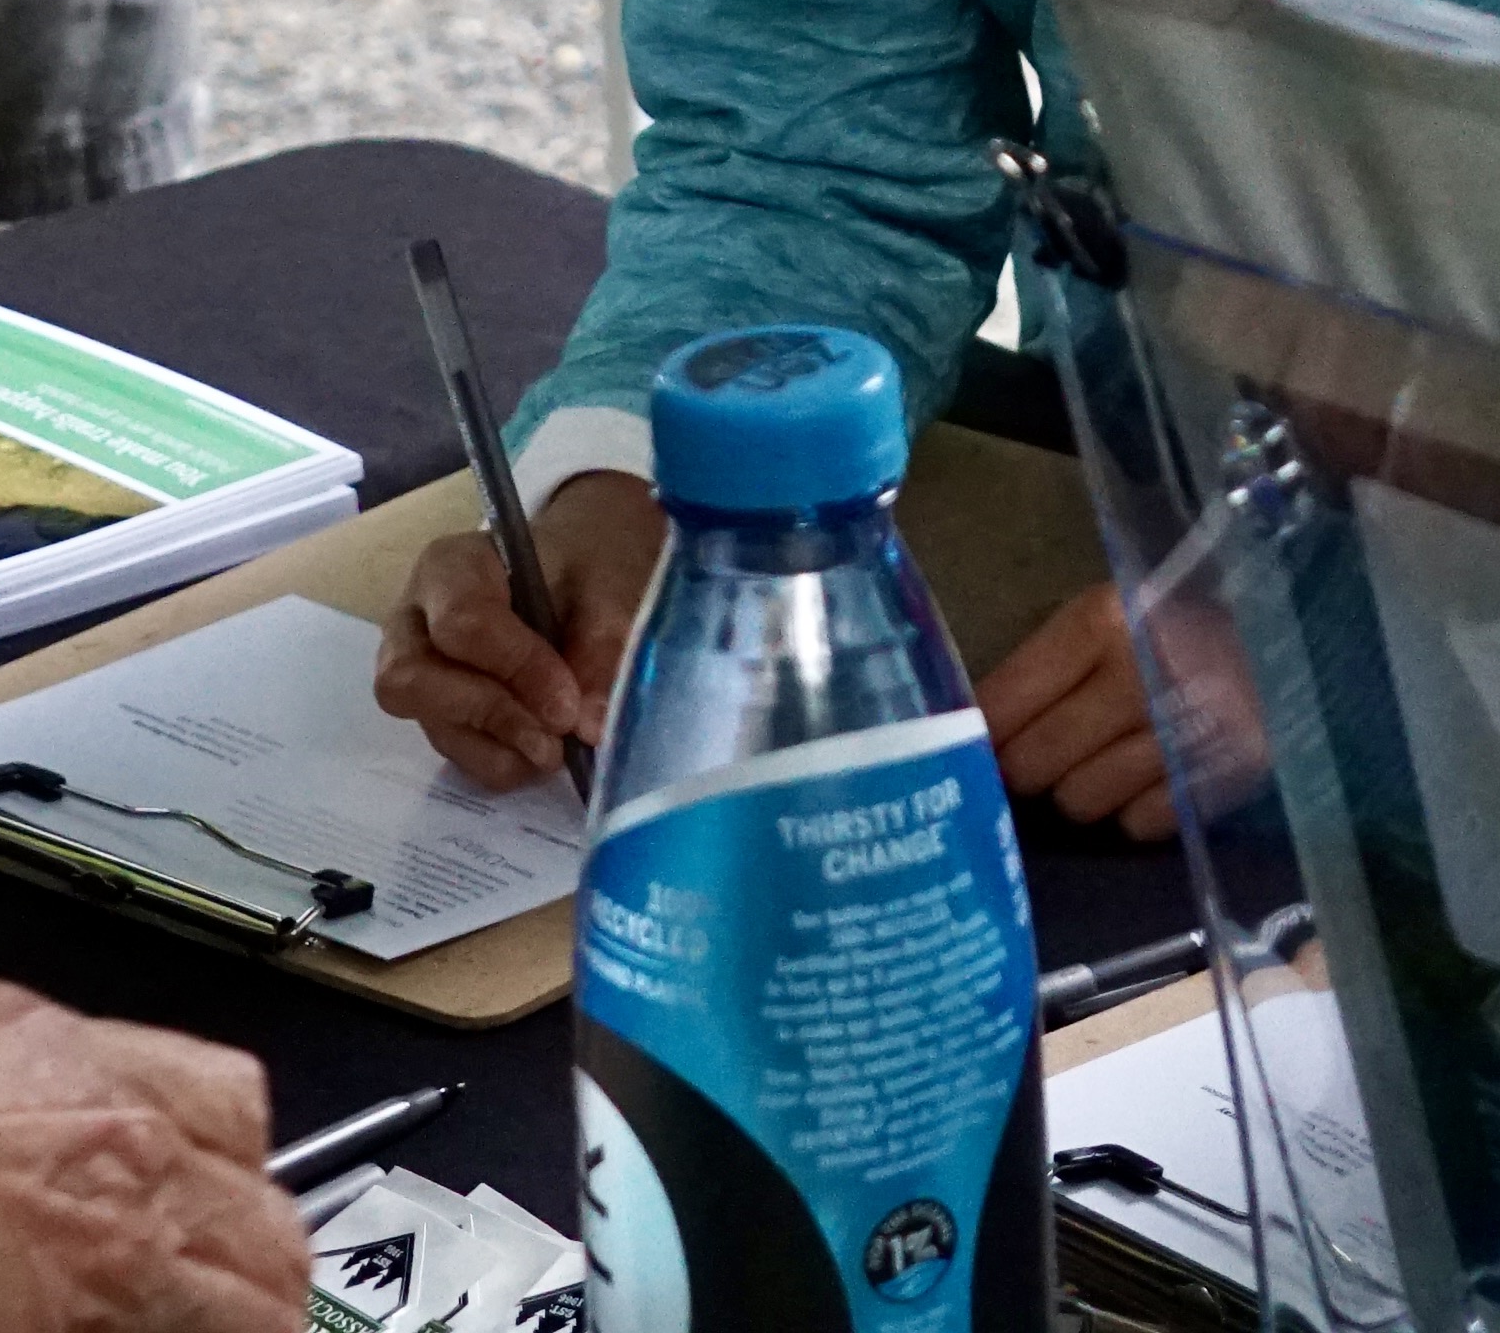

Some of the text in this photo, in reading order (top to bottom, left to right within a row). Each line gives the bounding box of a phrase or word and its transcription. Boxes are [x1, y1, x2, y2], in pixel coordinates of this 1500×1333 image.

[776, 776, 963, 849] THIRSTY FOR
[822, 821, 947, 881] CHANGE
[549, 1303, 577, 1319] EST.
